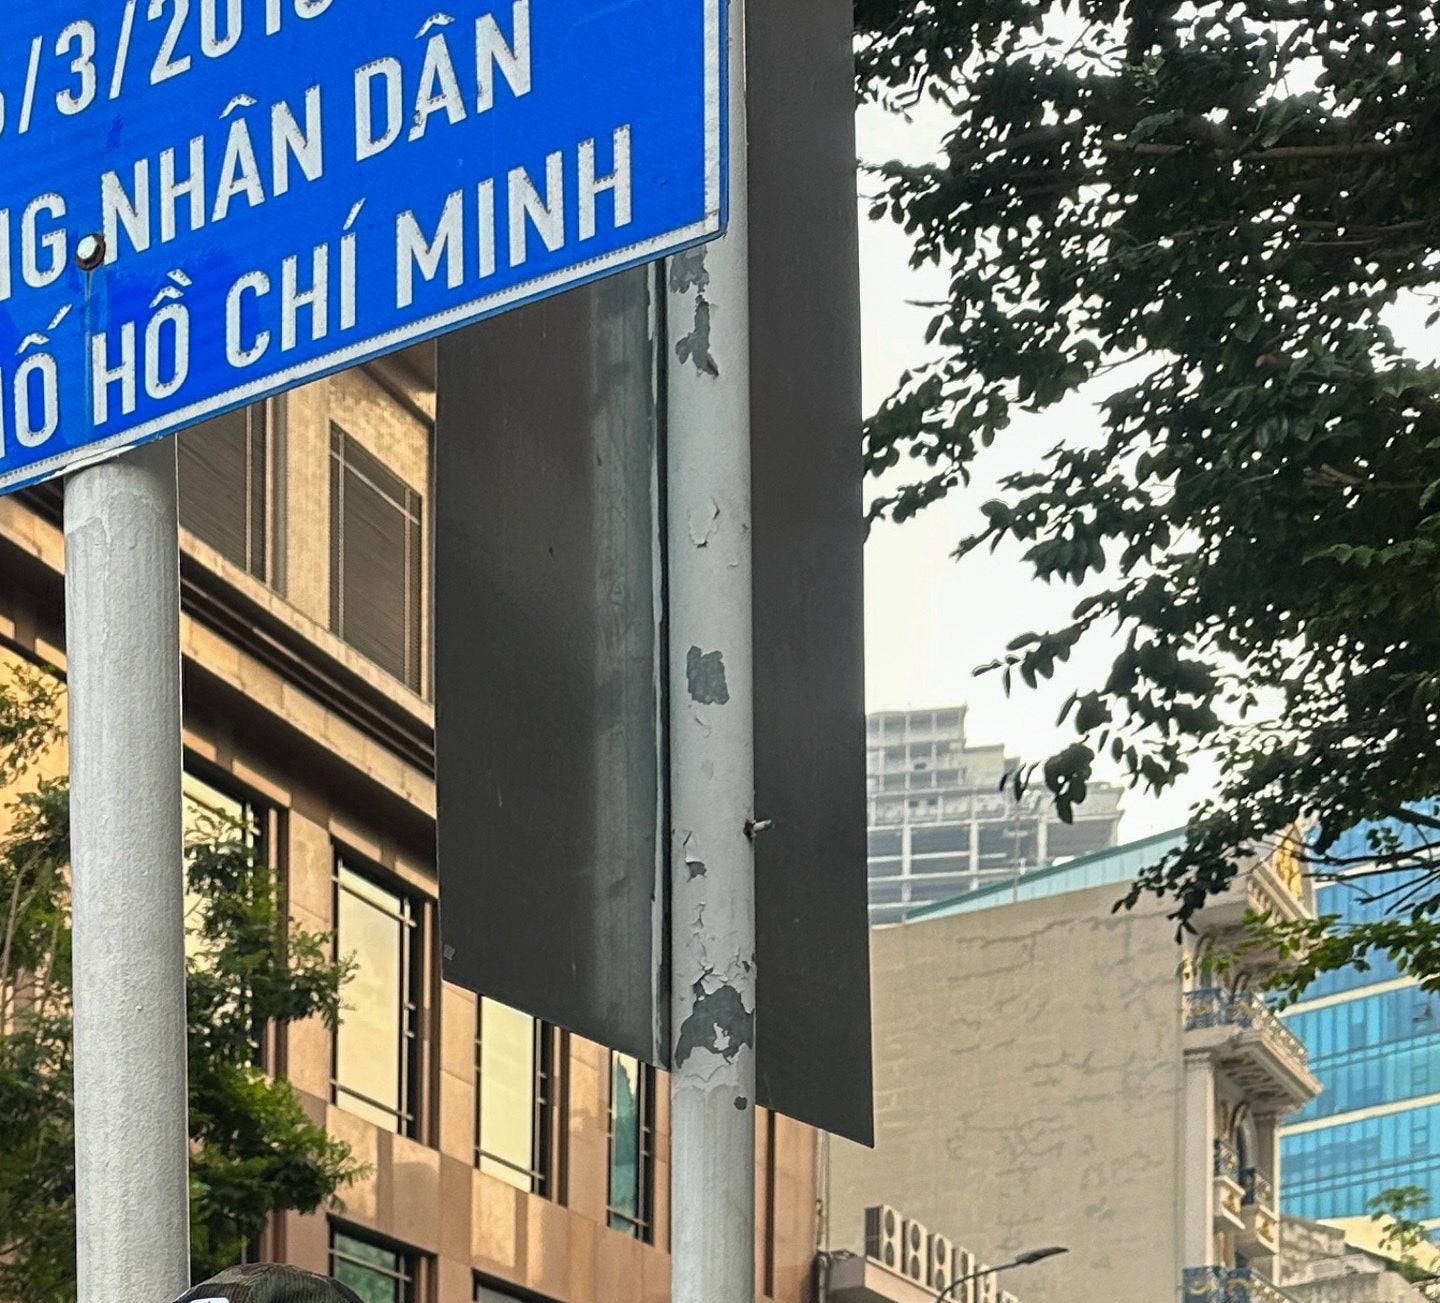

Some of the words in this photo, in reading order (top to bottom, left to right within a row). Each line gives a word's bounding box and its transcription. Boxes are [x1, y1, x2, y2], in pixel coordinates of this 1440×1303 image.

[101, 86, 323, 266] NHÂN
[355, 0, 531, 162] DÂN
[92, 270, 192, 425] HỒ
[226, 198, 365, 368] CHÍ
[396, 125, 632, 309] MINH
